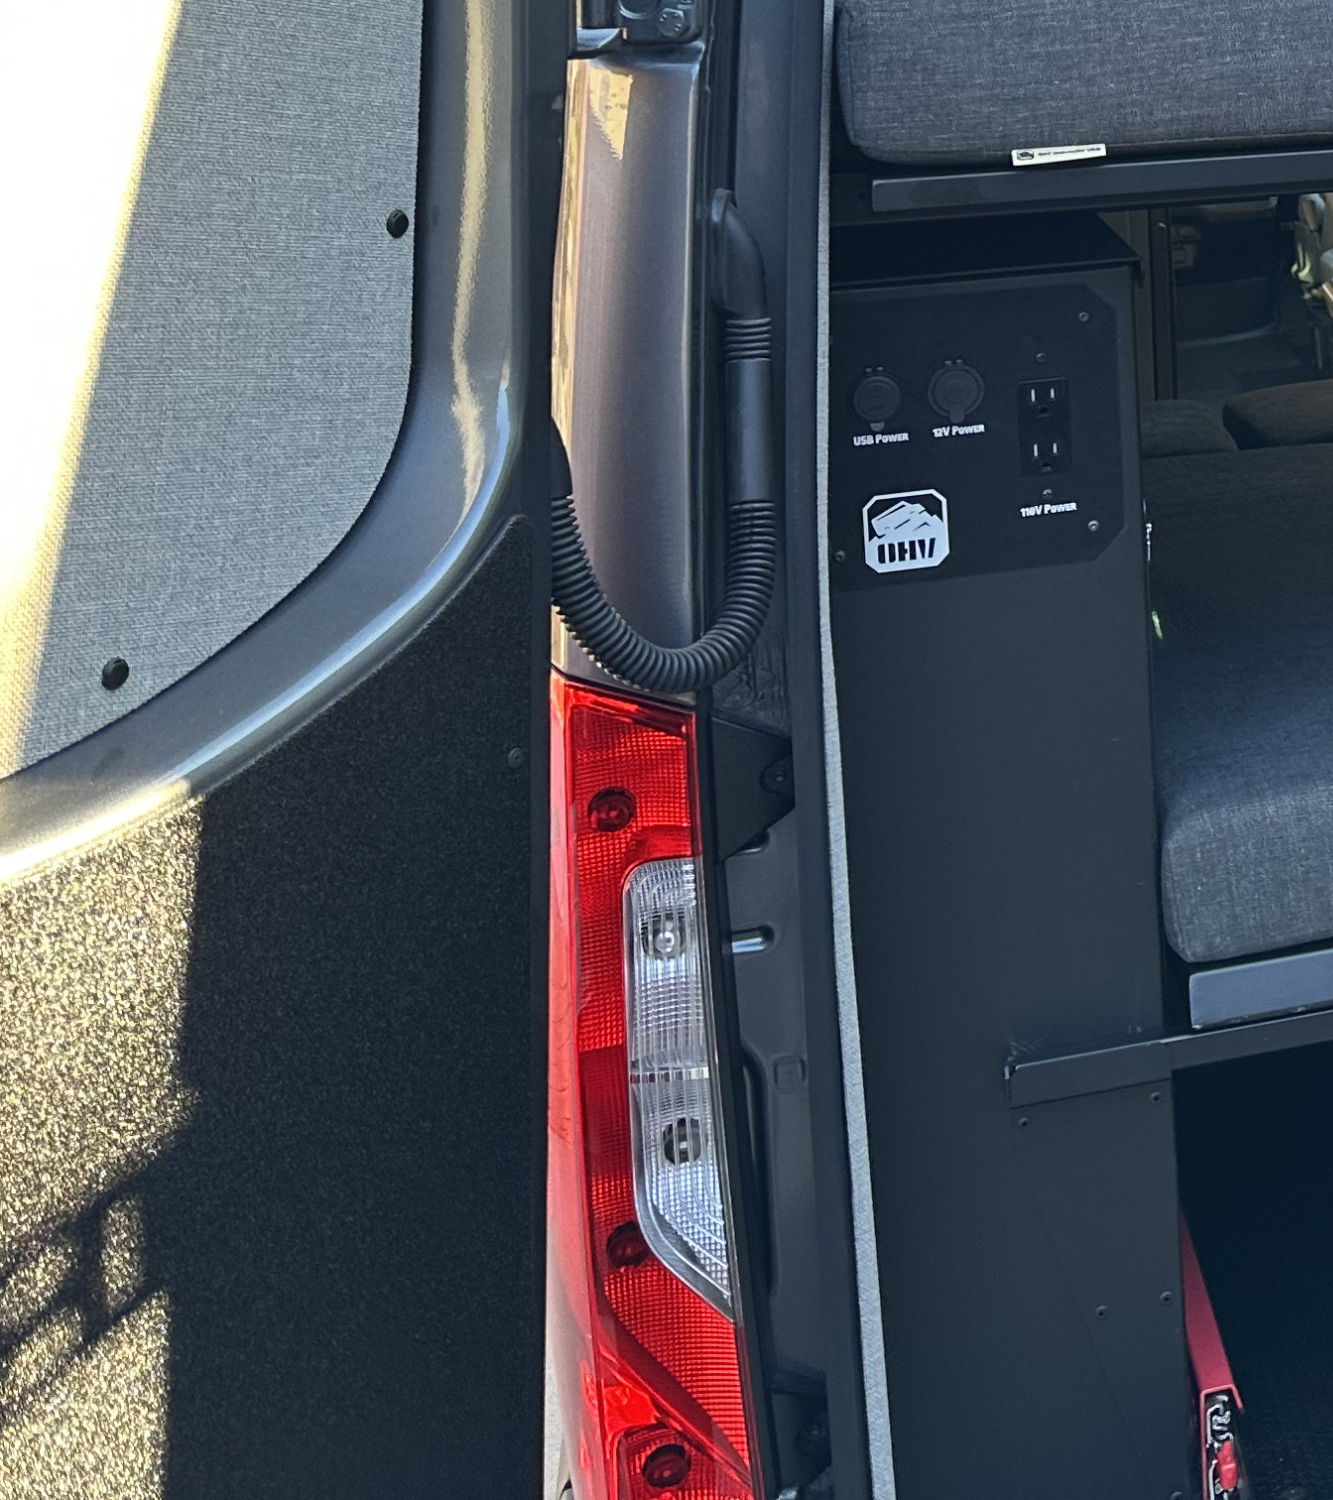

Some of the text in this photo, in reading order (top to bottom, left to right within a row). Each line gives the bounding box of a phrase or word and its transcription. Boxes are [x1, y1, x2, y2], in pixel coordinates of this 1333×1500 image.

[932, 424, 985, 438] 12V POWER
[853, 432, 909, 446] USB POWER
[1020, 502, 1077, 518] 110V POWER
